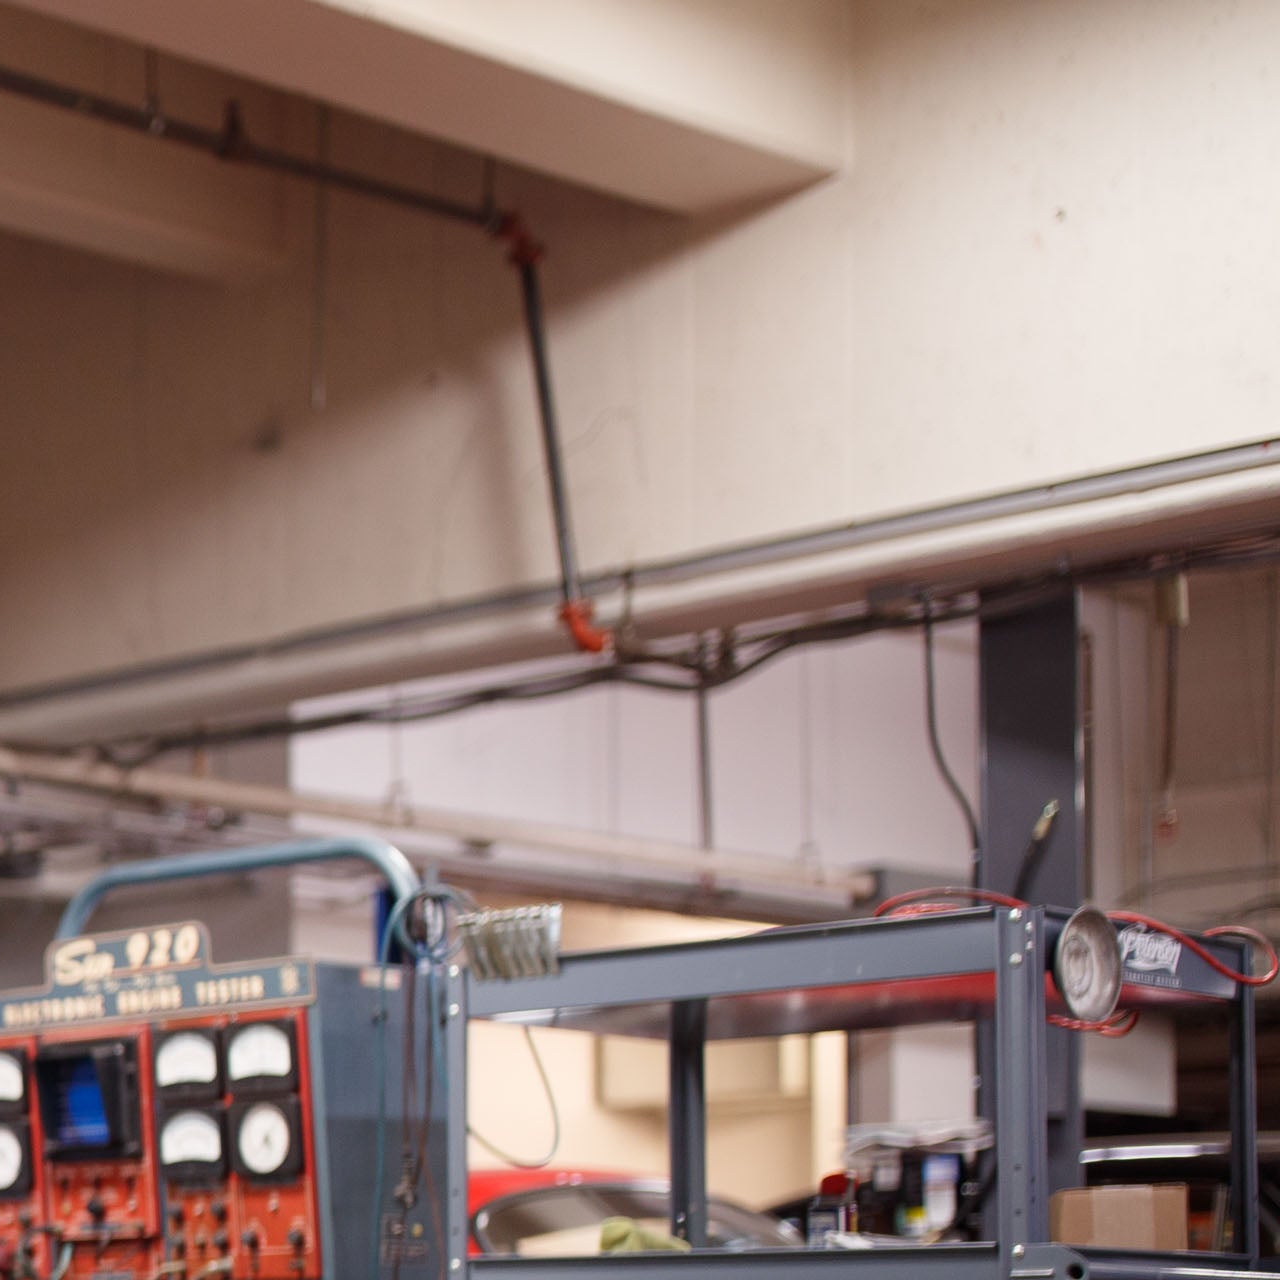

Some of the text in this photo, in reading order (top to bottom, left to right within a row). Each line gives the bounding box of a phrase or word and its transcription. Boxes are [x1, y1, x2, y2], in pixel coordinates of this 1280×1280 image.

[125, 924, 200, 969] 920
[116, 985, 183, 1015] ENGINE
[194, 974, 265, 1005] TESTER
